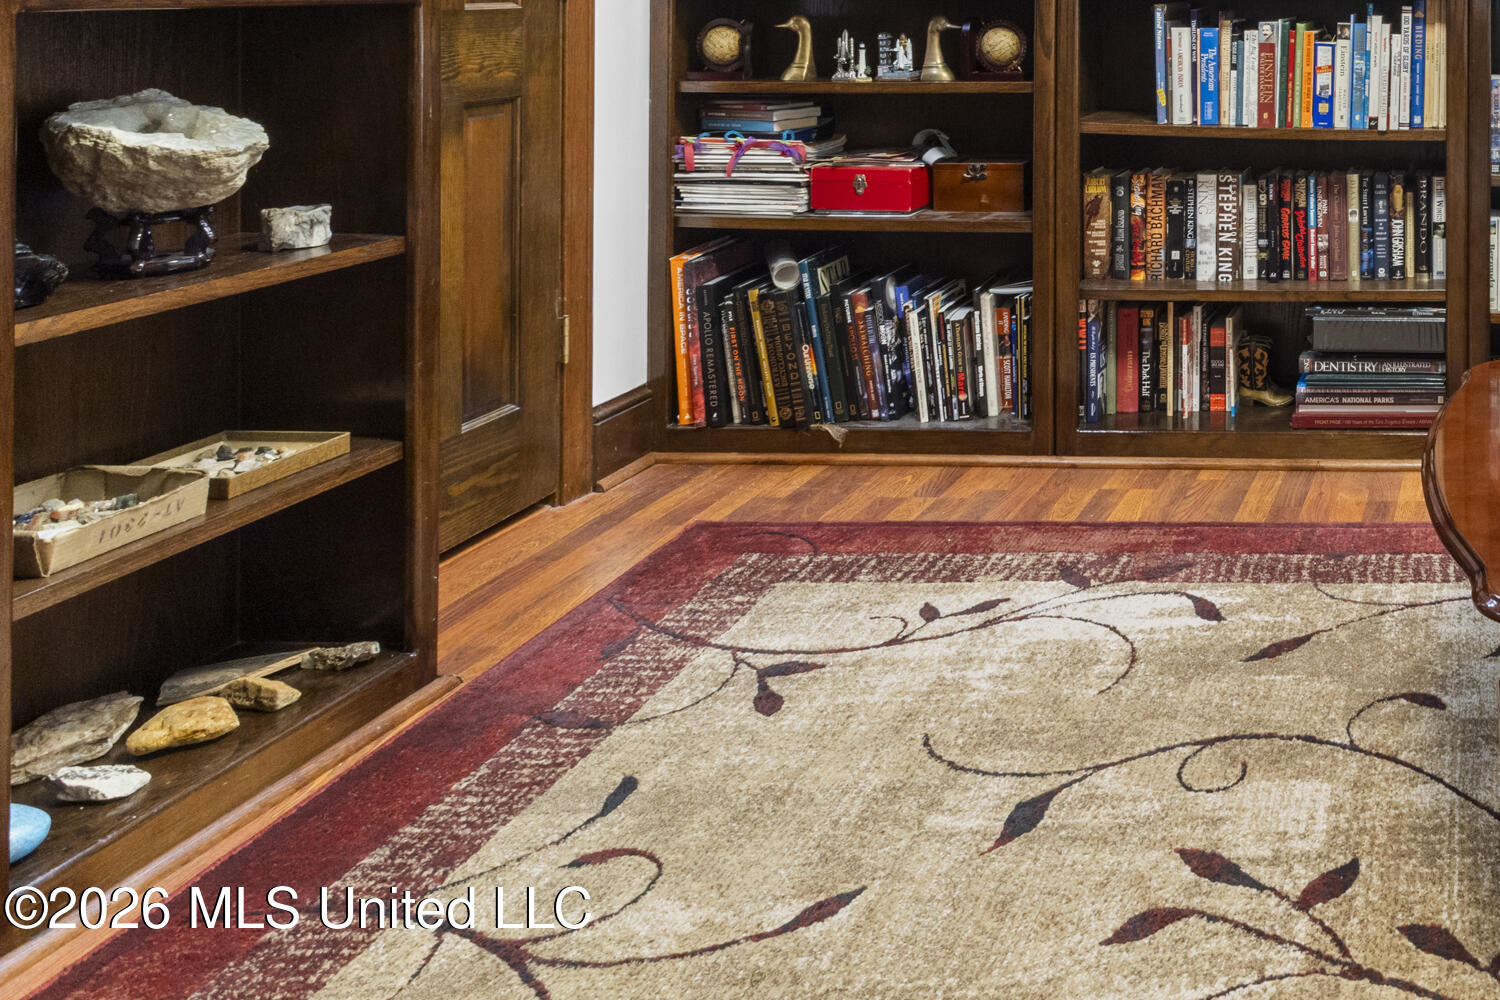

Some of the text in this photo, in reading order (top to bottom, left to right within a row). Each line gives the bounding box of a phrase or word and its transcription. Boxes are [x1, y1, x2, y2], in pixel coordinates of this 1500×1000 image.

[1403, 46, 1409, 54] OF
[1415, 25, 1423, 60] BIRDING
[1208, 48, 1216, 91] The American
[1264, 52, 1273, 103] EINSTEIN
[1198, 181, 1208, 215] KING
[1419, 180, 1427, 253] BRANDO
[1150, 174, 1162, 280] RICHARD BACHMAN
[1218, 175, 1232, 282] STEPHEN KING
[1244, 217, 1257, 258] STORYVILLE
[1392, 219, 1404, 266] JOHN GRISHAM
[679, 312, 684, 321] IN
[702, 312, 717, 407] APOLLO REMASTERED
[729, 327, 737, 347] FIRST
[733, 350, 739, 361] ON
[857, 320, 872, 376] SKYWATCHING
[1003, 360, 1012, 399] SCOTT HAMILTON
[1142, 351, 1150, 397] The Dark Half
[1314, 361, 1378, 373] DENTISTRY
